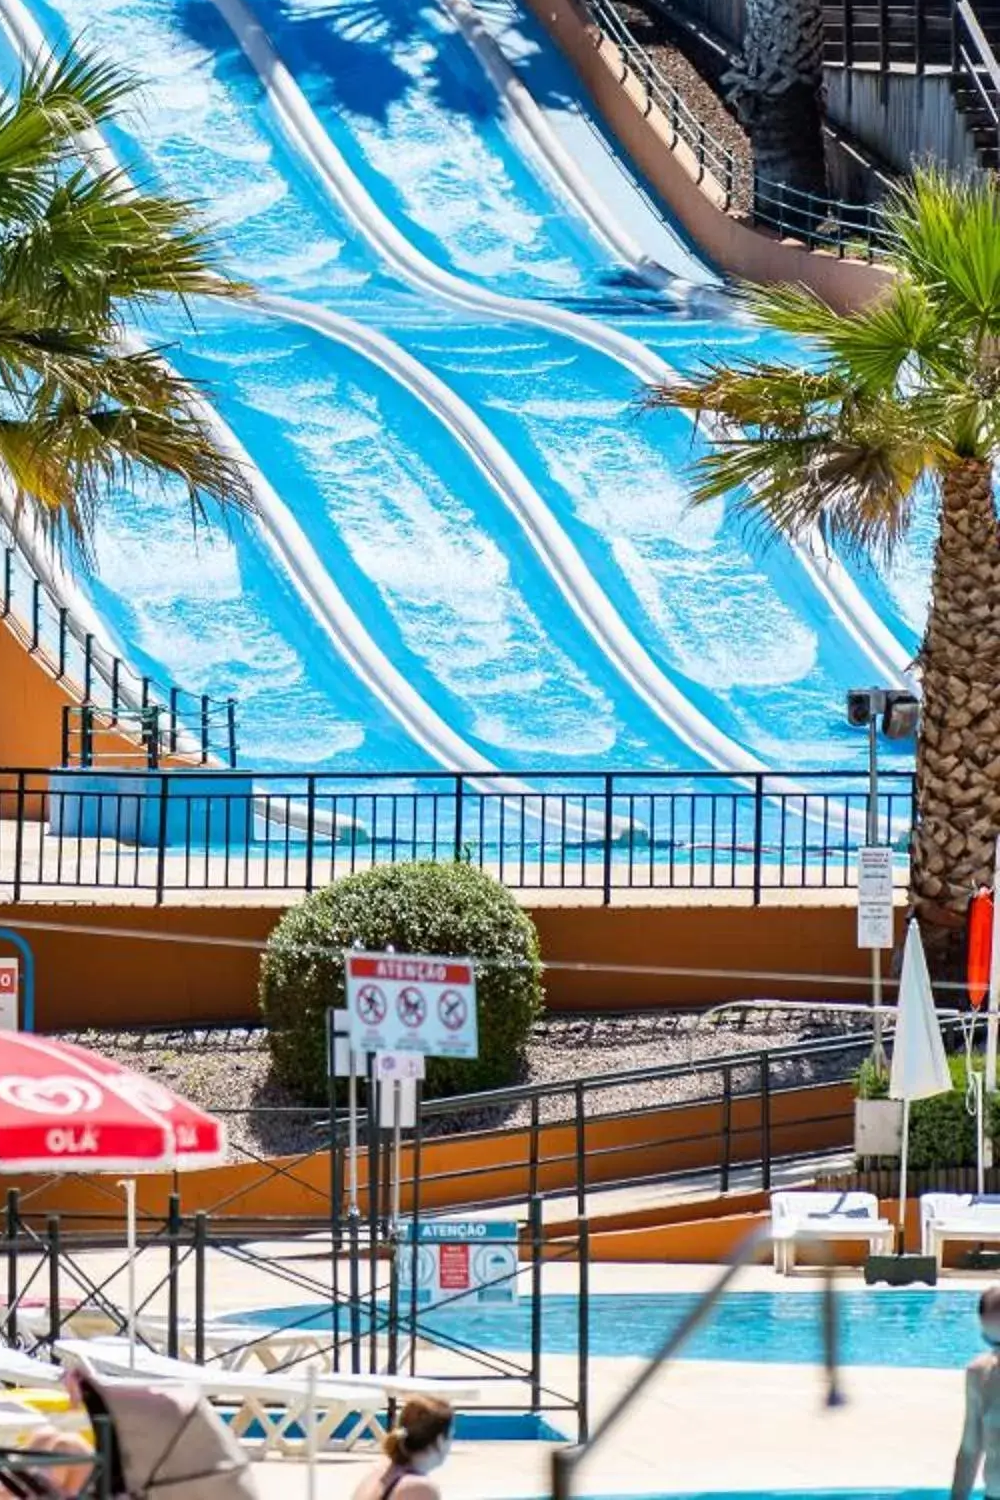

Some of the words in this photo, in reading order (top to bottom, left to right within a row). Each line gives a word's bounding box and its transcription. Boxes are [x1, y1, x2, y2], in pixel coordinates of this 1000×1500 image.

[377, 960, 447, 981] ATENÇÃO
[45, 1122, 99, 1154] OLÁ
[421, 1223, 487, 1238] ATENÇÃO
